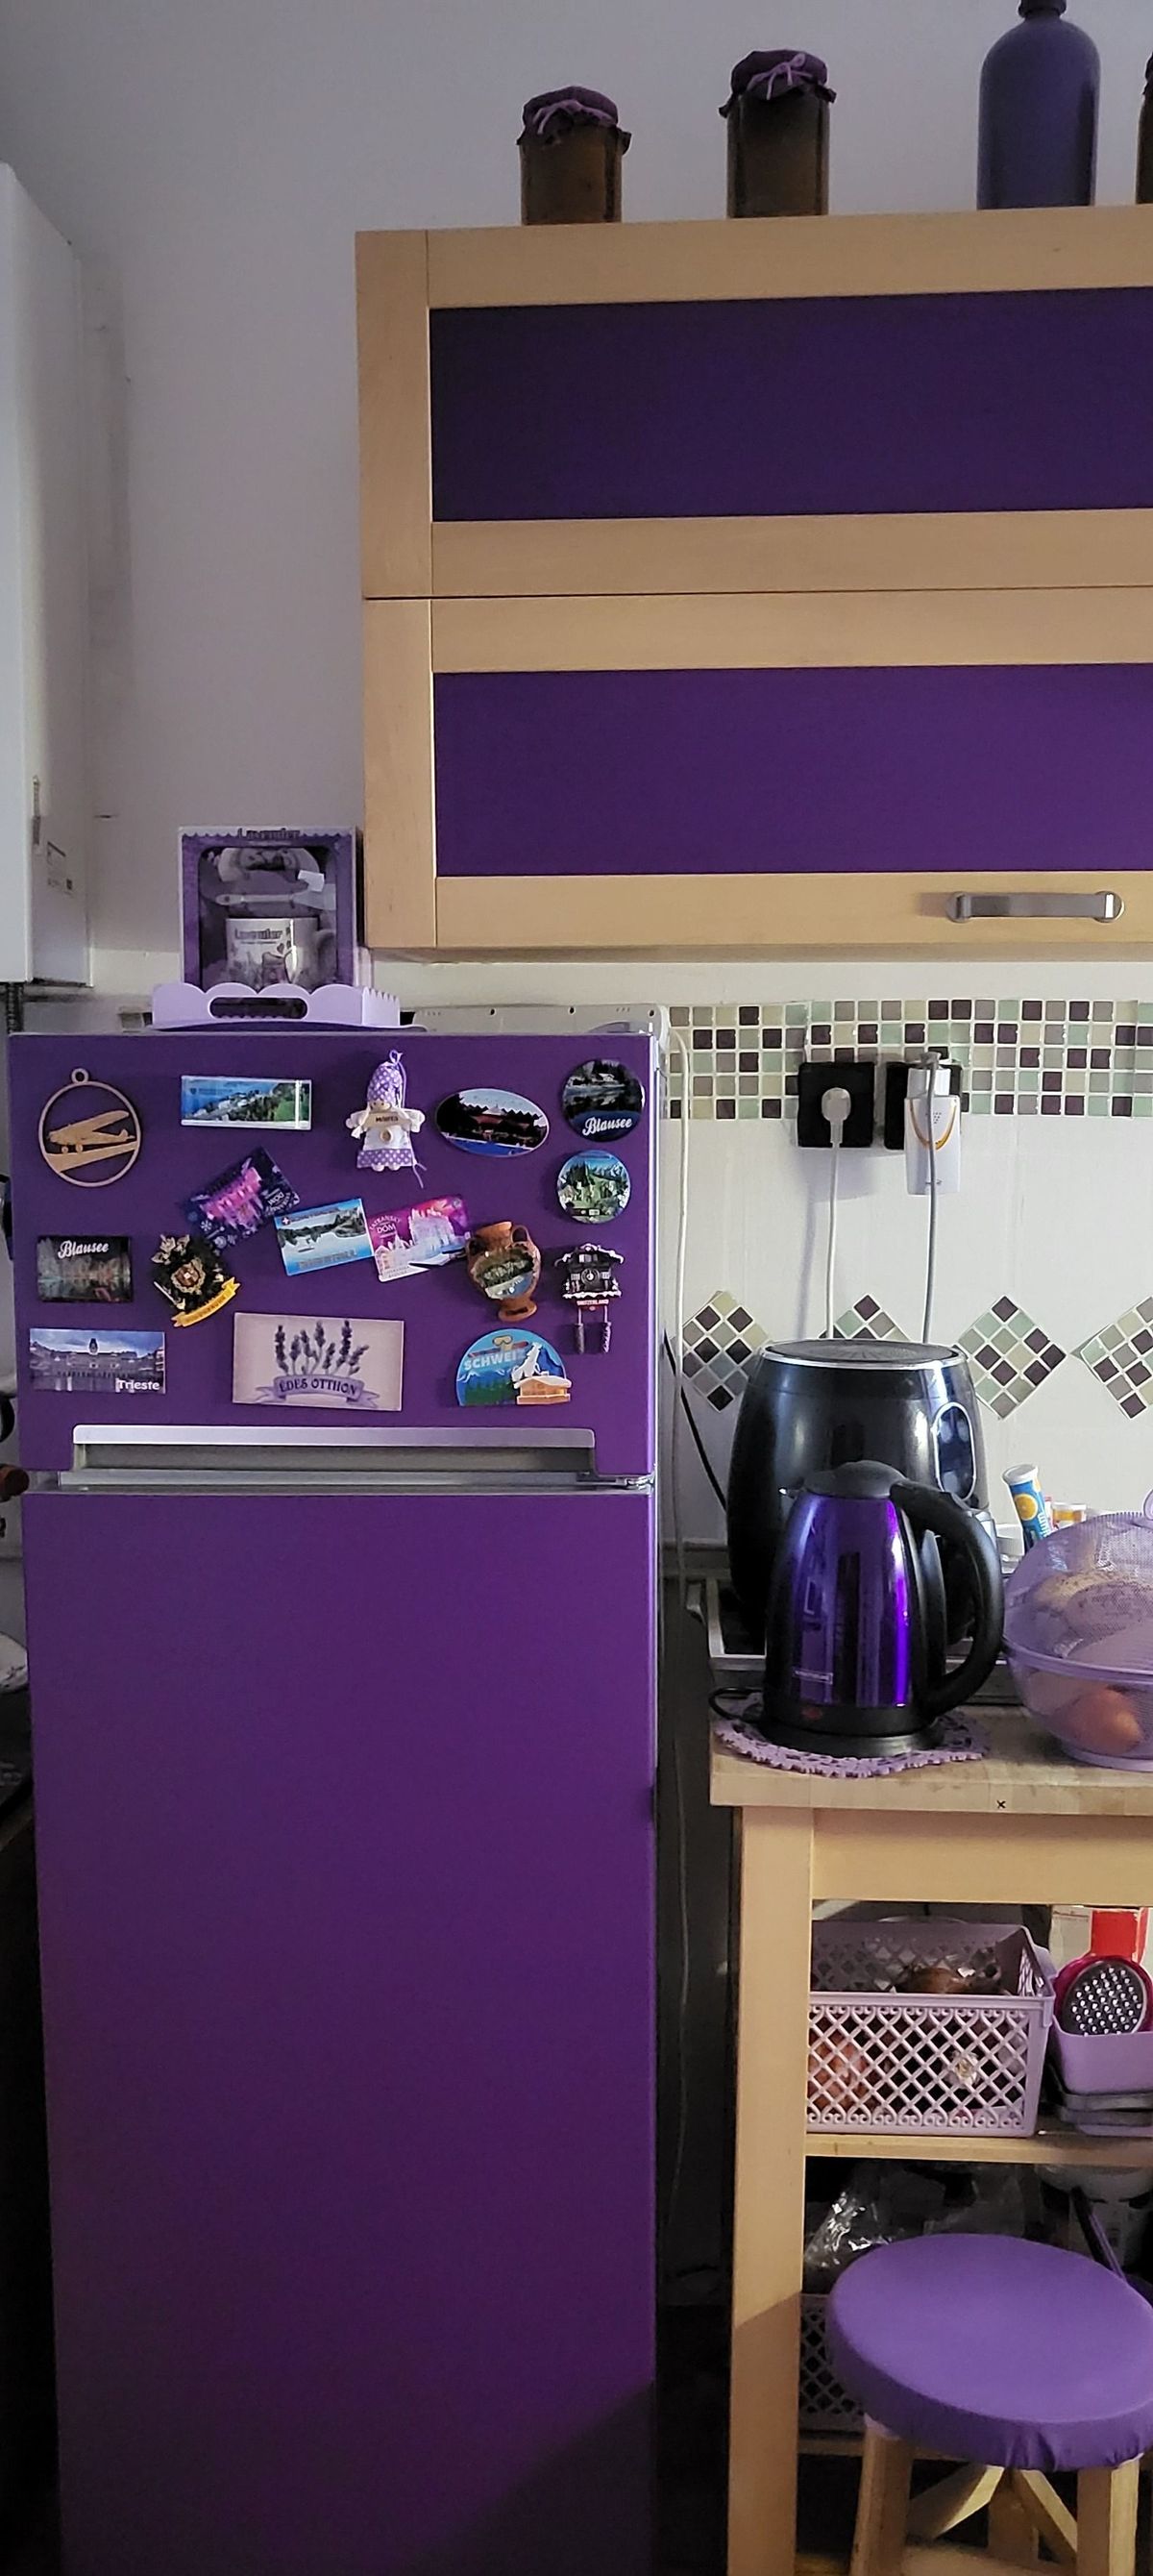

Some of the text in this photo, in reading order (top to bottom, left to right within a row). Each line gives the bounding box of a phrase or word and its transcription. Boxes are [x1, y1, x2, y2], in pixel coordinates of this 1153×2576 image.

[582, 1116, 633, 1136] Blausee
[58, 1240, 110, 1259] Blausee
[117, 1379, 160, 1391] Trieste
[310, 1377, 357, 1396] OTTHON
